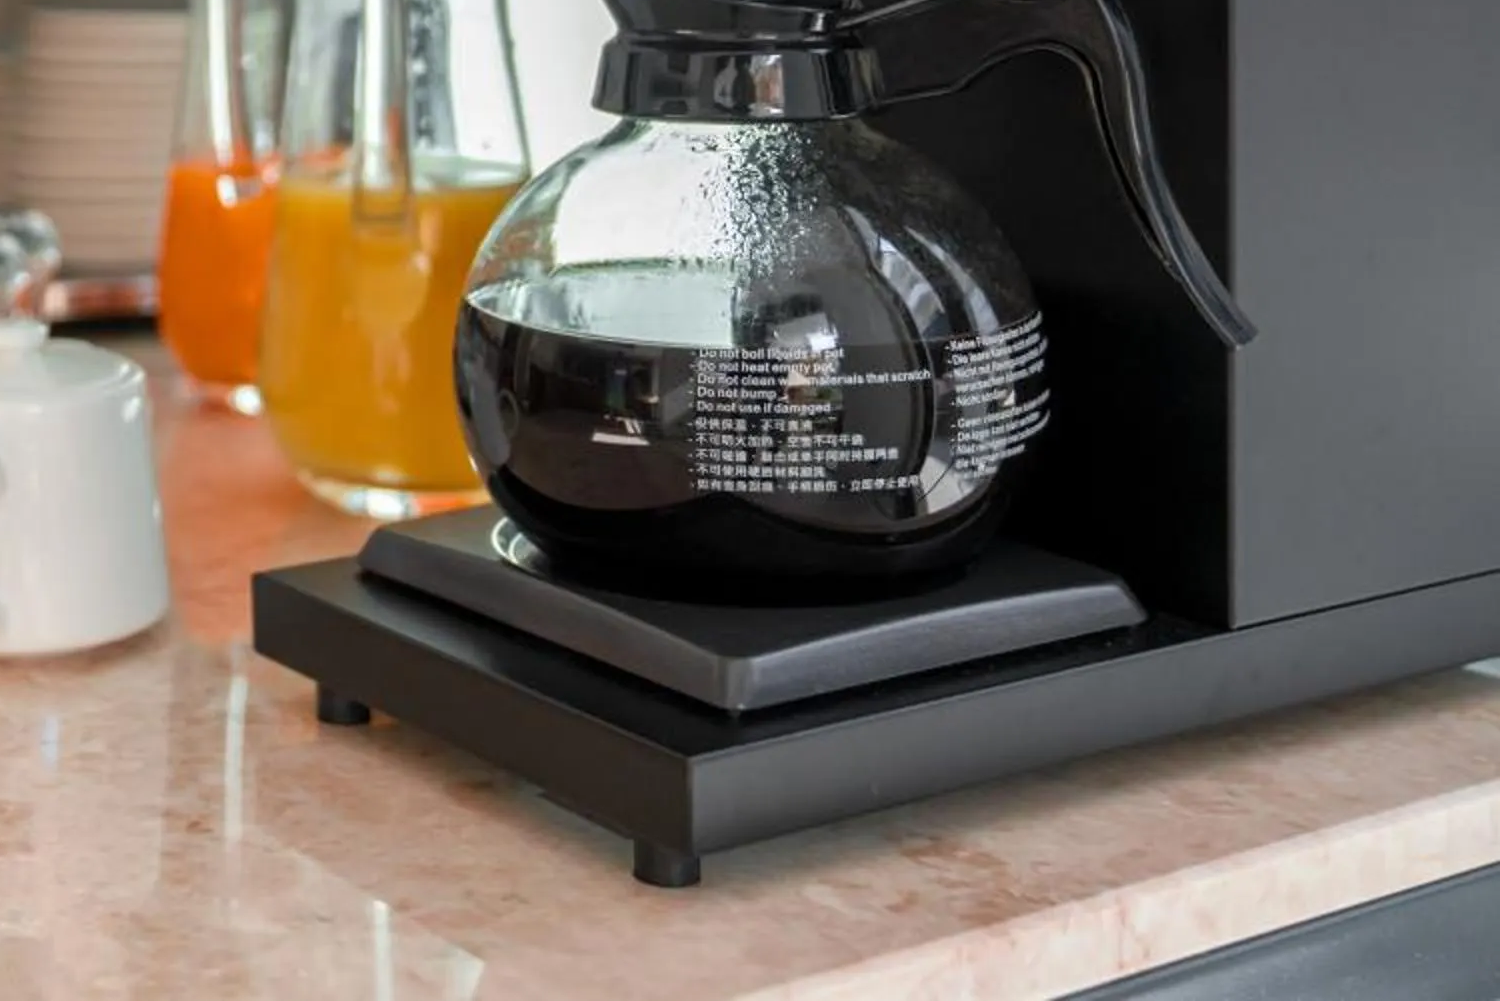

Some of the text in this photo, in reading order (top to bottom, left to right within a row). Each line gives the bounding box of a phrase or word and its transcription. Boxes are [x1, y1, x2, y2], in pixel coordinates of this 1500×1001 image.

[699, 348, 717, 359] Do
[719, 348, 740, 359] not
[697, 359, 716, 372] Do
[719, 360, 739, 372] not
[741, 361, 770, 374] heat
[772, 362, 811, 376] empty
[697, 373, 715, 385] Do
[717, 374, 739, 386] not
[741, 374, 776, 386] clean
[808, 373, 864, 387] materials
[865, 372, 889, 384] that
[890, 369, 931, 383] scratch
[697, 386, 777, 401] Do not bump
[696, 400, 831, 416] Do not use if damaged
